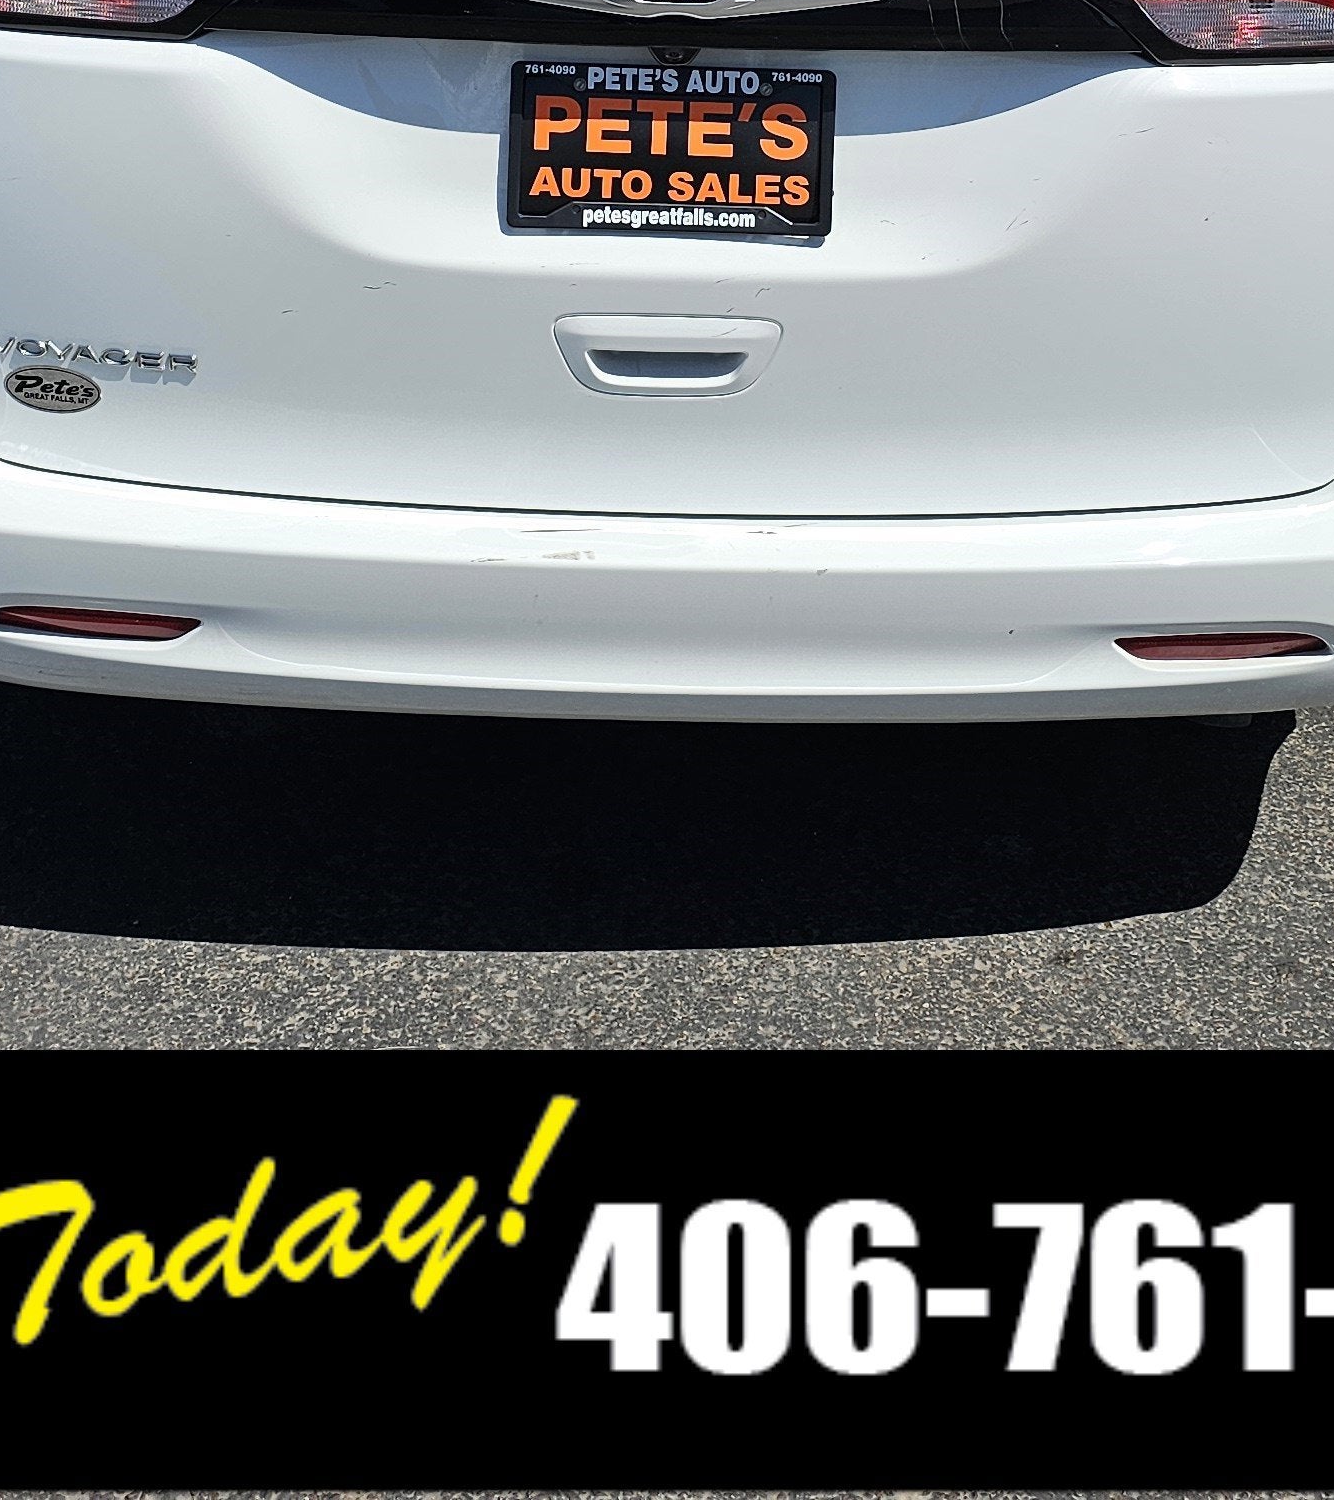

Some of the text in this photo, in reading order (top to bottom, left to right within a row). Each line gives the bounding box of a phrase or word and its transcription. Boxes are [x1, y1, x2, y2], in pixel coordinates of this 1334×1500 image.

[524, 63, 576, 75] 761-4090
[587, 66, 760, 94] PETE'S AUTO
[771, 71, 823, 84] 761-4090
[533, 95, 809, 160] PETE'S
[529, 166, 810, 206] AUTO SALES
[582, 206, 755, 228] petesgreatfalls.com
[14, 374, 95, 398] Pete's
[23, 391, 49, 400] GREAT
[77, 397, 90, 405] MT
